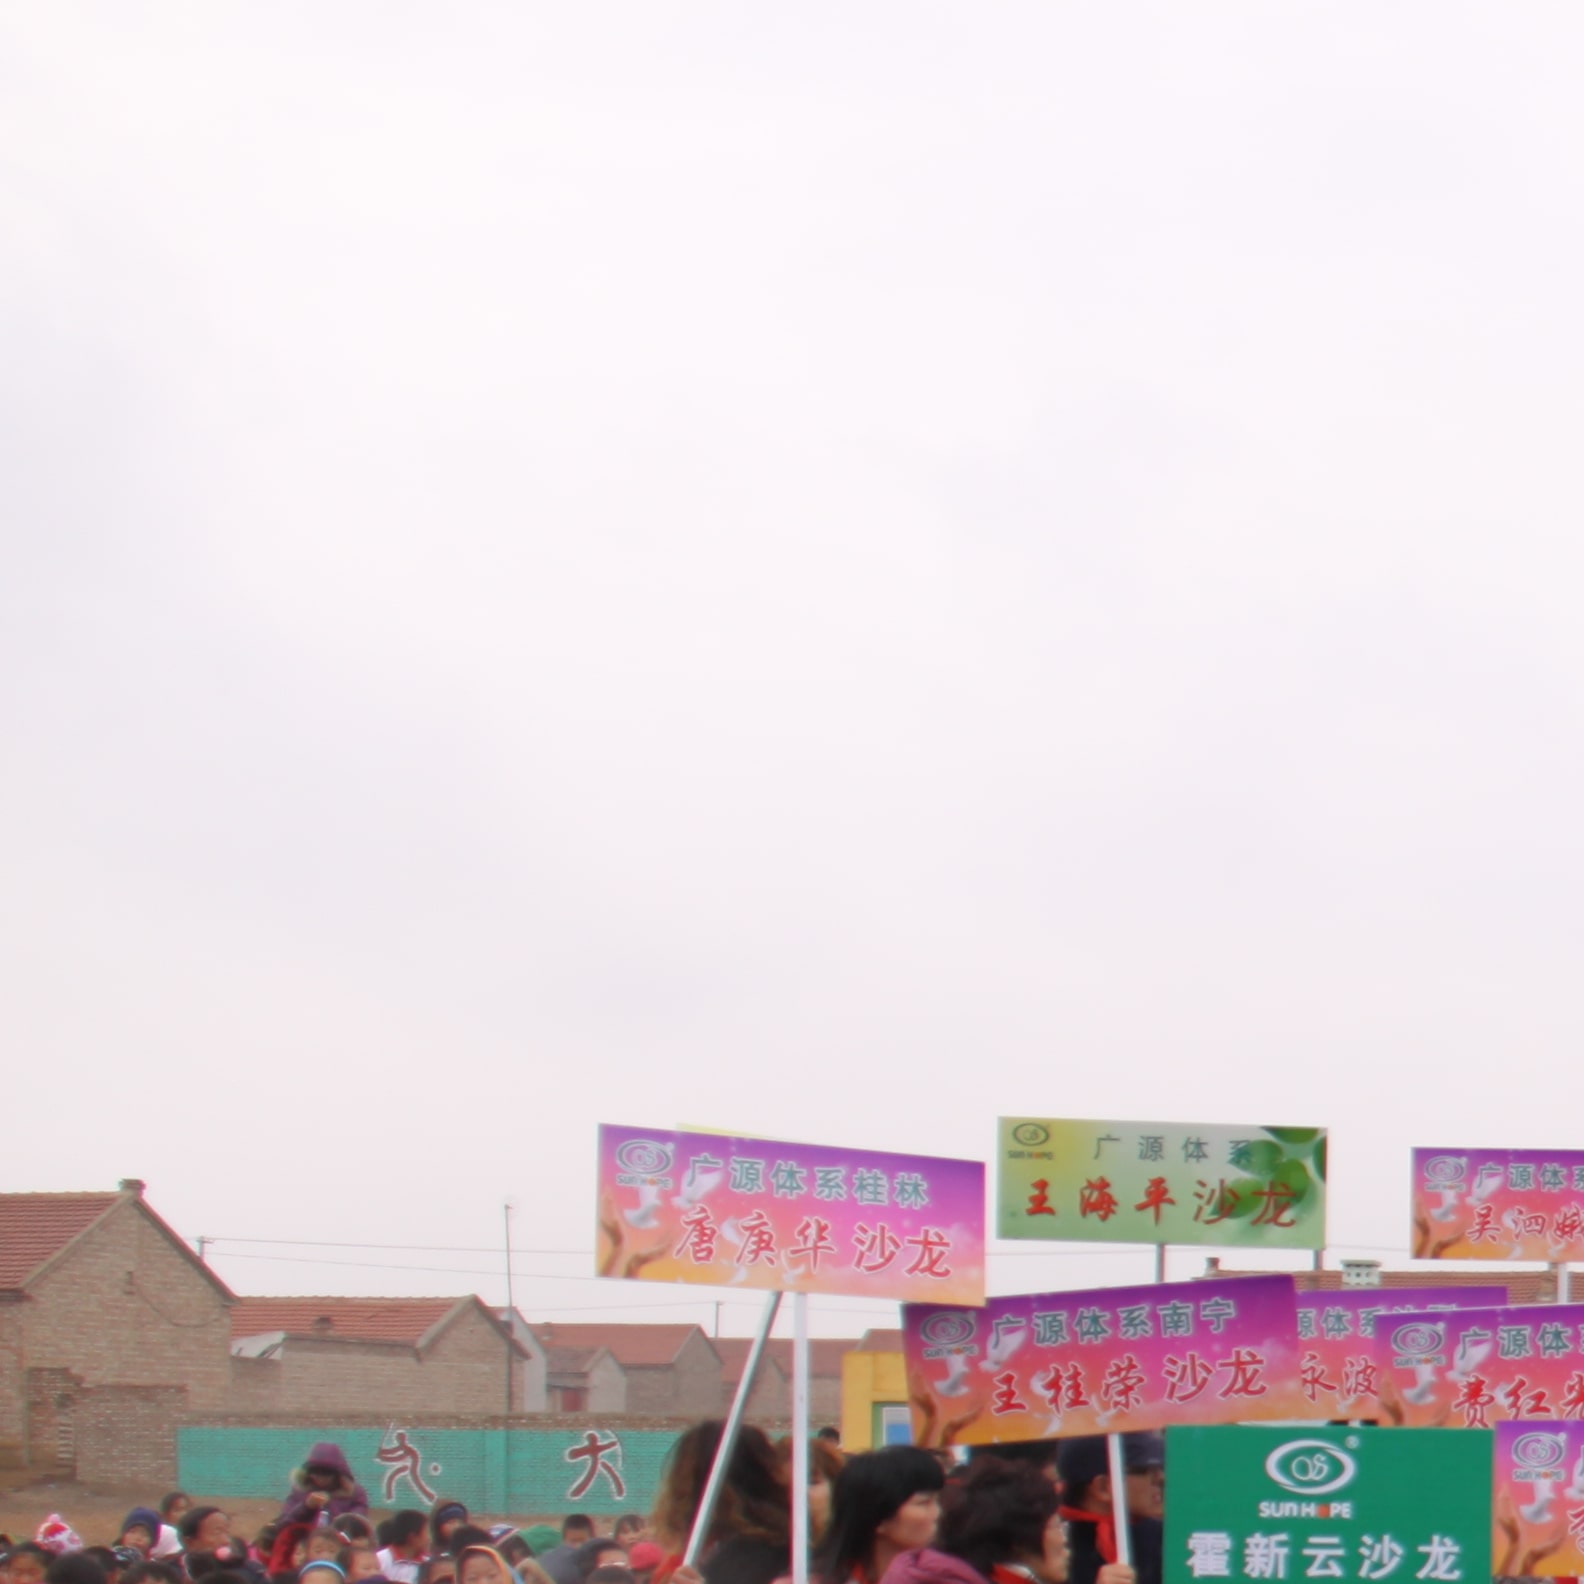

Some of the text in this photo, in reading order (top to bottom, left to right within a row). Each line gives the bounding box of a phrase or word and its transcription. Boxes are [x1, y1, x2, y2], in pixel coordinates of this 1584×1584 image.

[1093, 1135, 1254, 1164] 广源体系
[687, 1153, 930, 1209] 广源体系桂林
[1025, 1175, 1297, 1228] 王海平沙龙
[673, 1205, 953, 1279] 唐庚华沙龙
[991, 1299, 1237, 1350] 广源体系南宁
[991, 1350, 1268, 1416] 王桂荣沙龙
[1186, 1531, 1463, 1581] 霍新云沙龙
